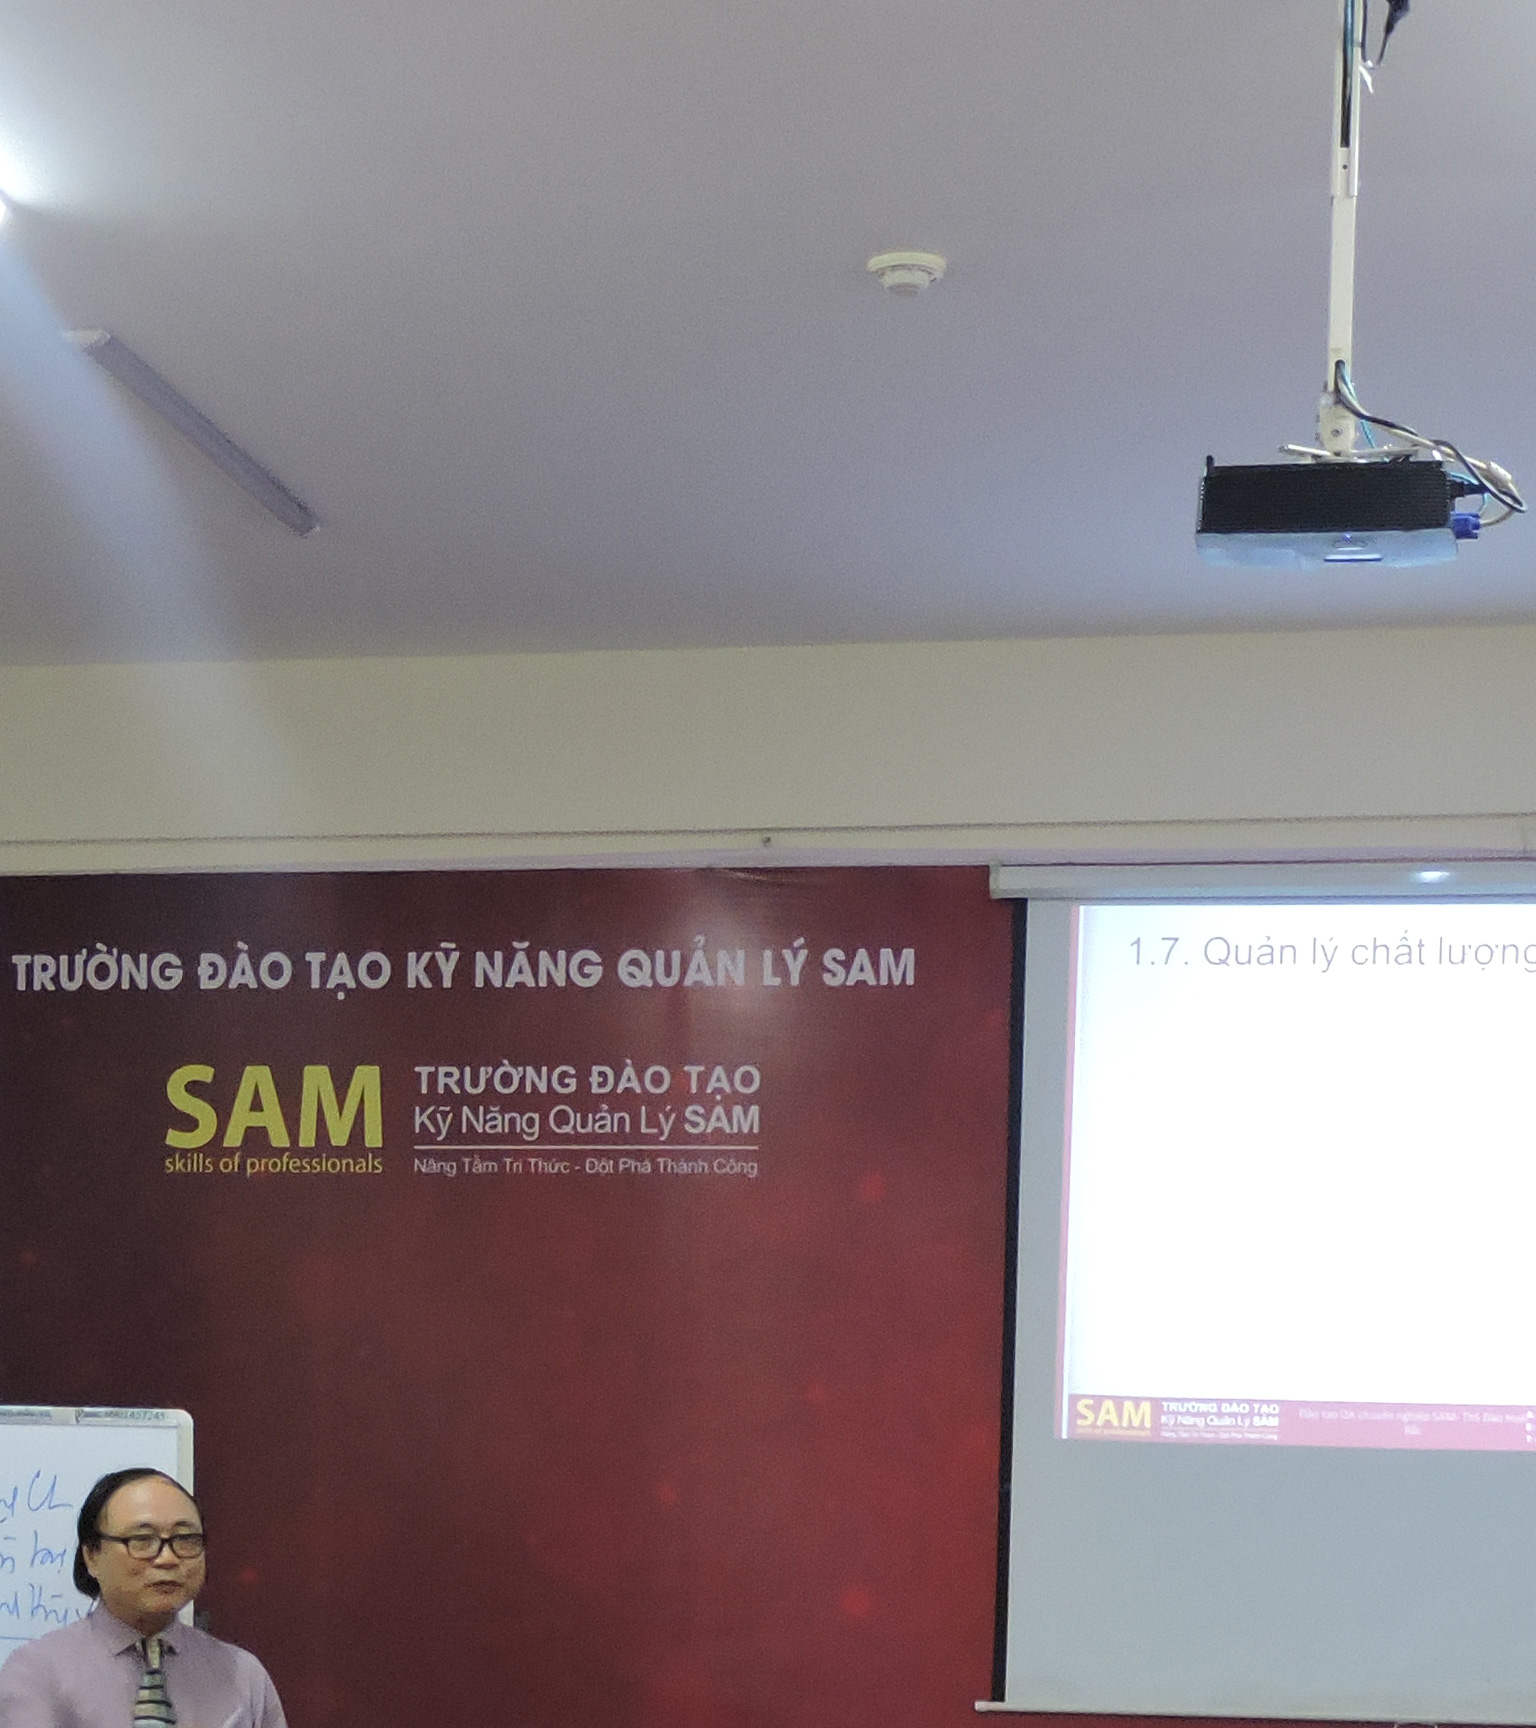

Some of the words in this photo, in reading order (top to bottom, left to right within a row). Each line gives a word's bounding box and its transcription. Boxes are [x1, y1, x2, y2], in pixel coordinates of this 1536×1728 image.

[11, 942, 183, 991] TRƯỜNG
[197, 941, 293, 991] ĐÀO
[305, 951, 392, 1000] TẠO
[406, 942, 460, 989] KỸ
[474, 941, 604, 988] NĂNG
[617, 934, 746, 987] QUẢN
[760, 937, 809, 987] LÝ
[822, 948, 916, 987] SAM
[1129, 936, 1190, 966] 1.7.
[1203, 935, 1298, 967] Quản
[1312, 936, 1339, 973] lý
[1351, 929, 1426, 966] chất
[414, 1059, 577, 1095] TRƯỜNG
[589, 1059, 672, 1095] ĐÀO
[683, 1064, 762, 1099] TẠO
[165, 1064, 384, 1149] SAM
[414, 1104, 453, 1141] Kỹ
[461, 1104, 541, 1141] Năng
[549, 1103, 631, 1135] Quản
[640, 1104, 676, 1141] Lý
[684, 1104, 760, 1135] SAM
[165, 1152, 214, 1174] skills
[219, 1152, 243, 1174] of
[246, 1152, 384, 1180] professionals
[1076, 1398, 1152, 1428] SAM
